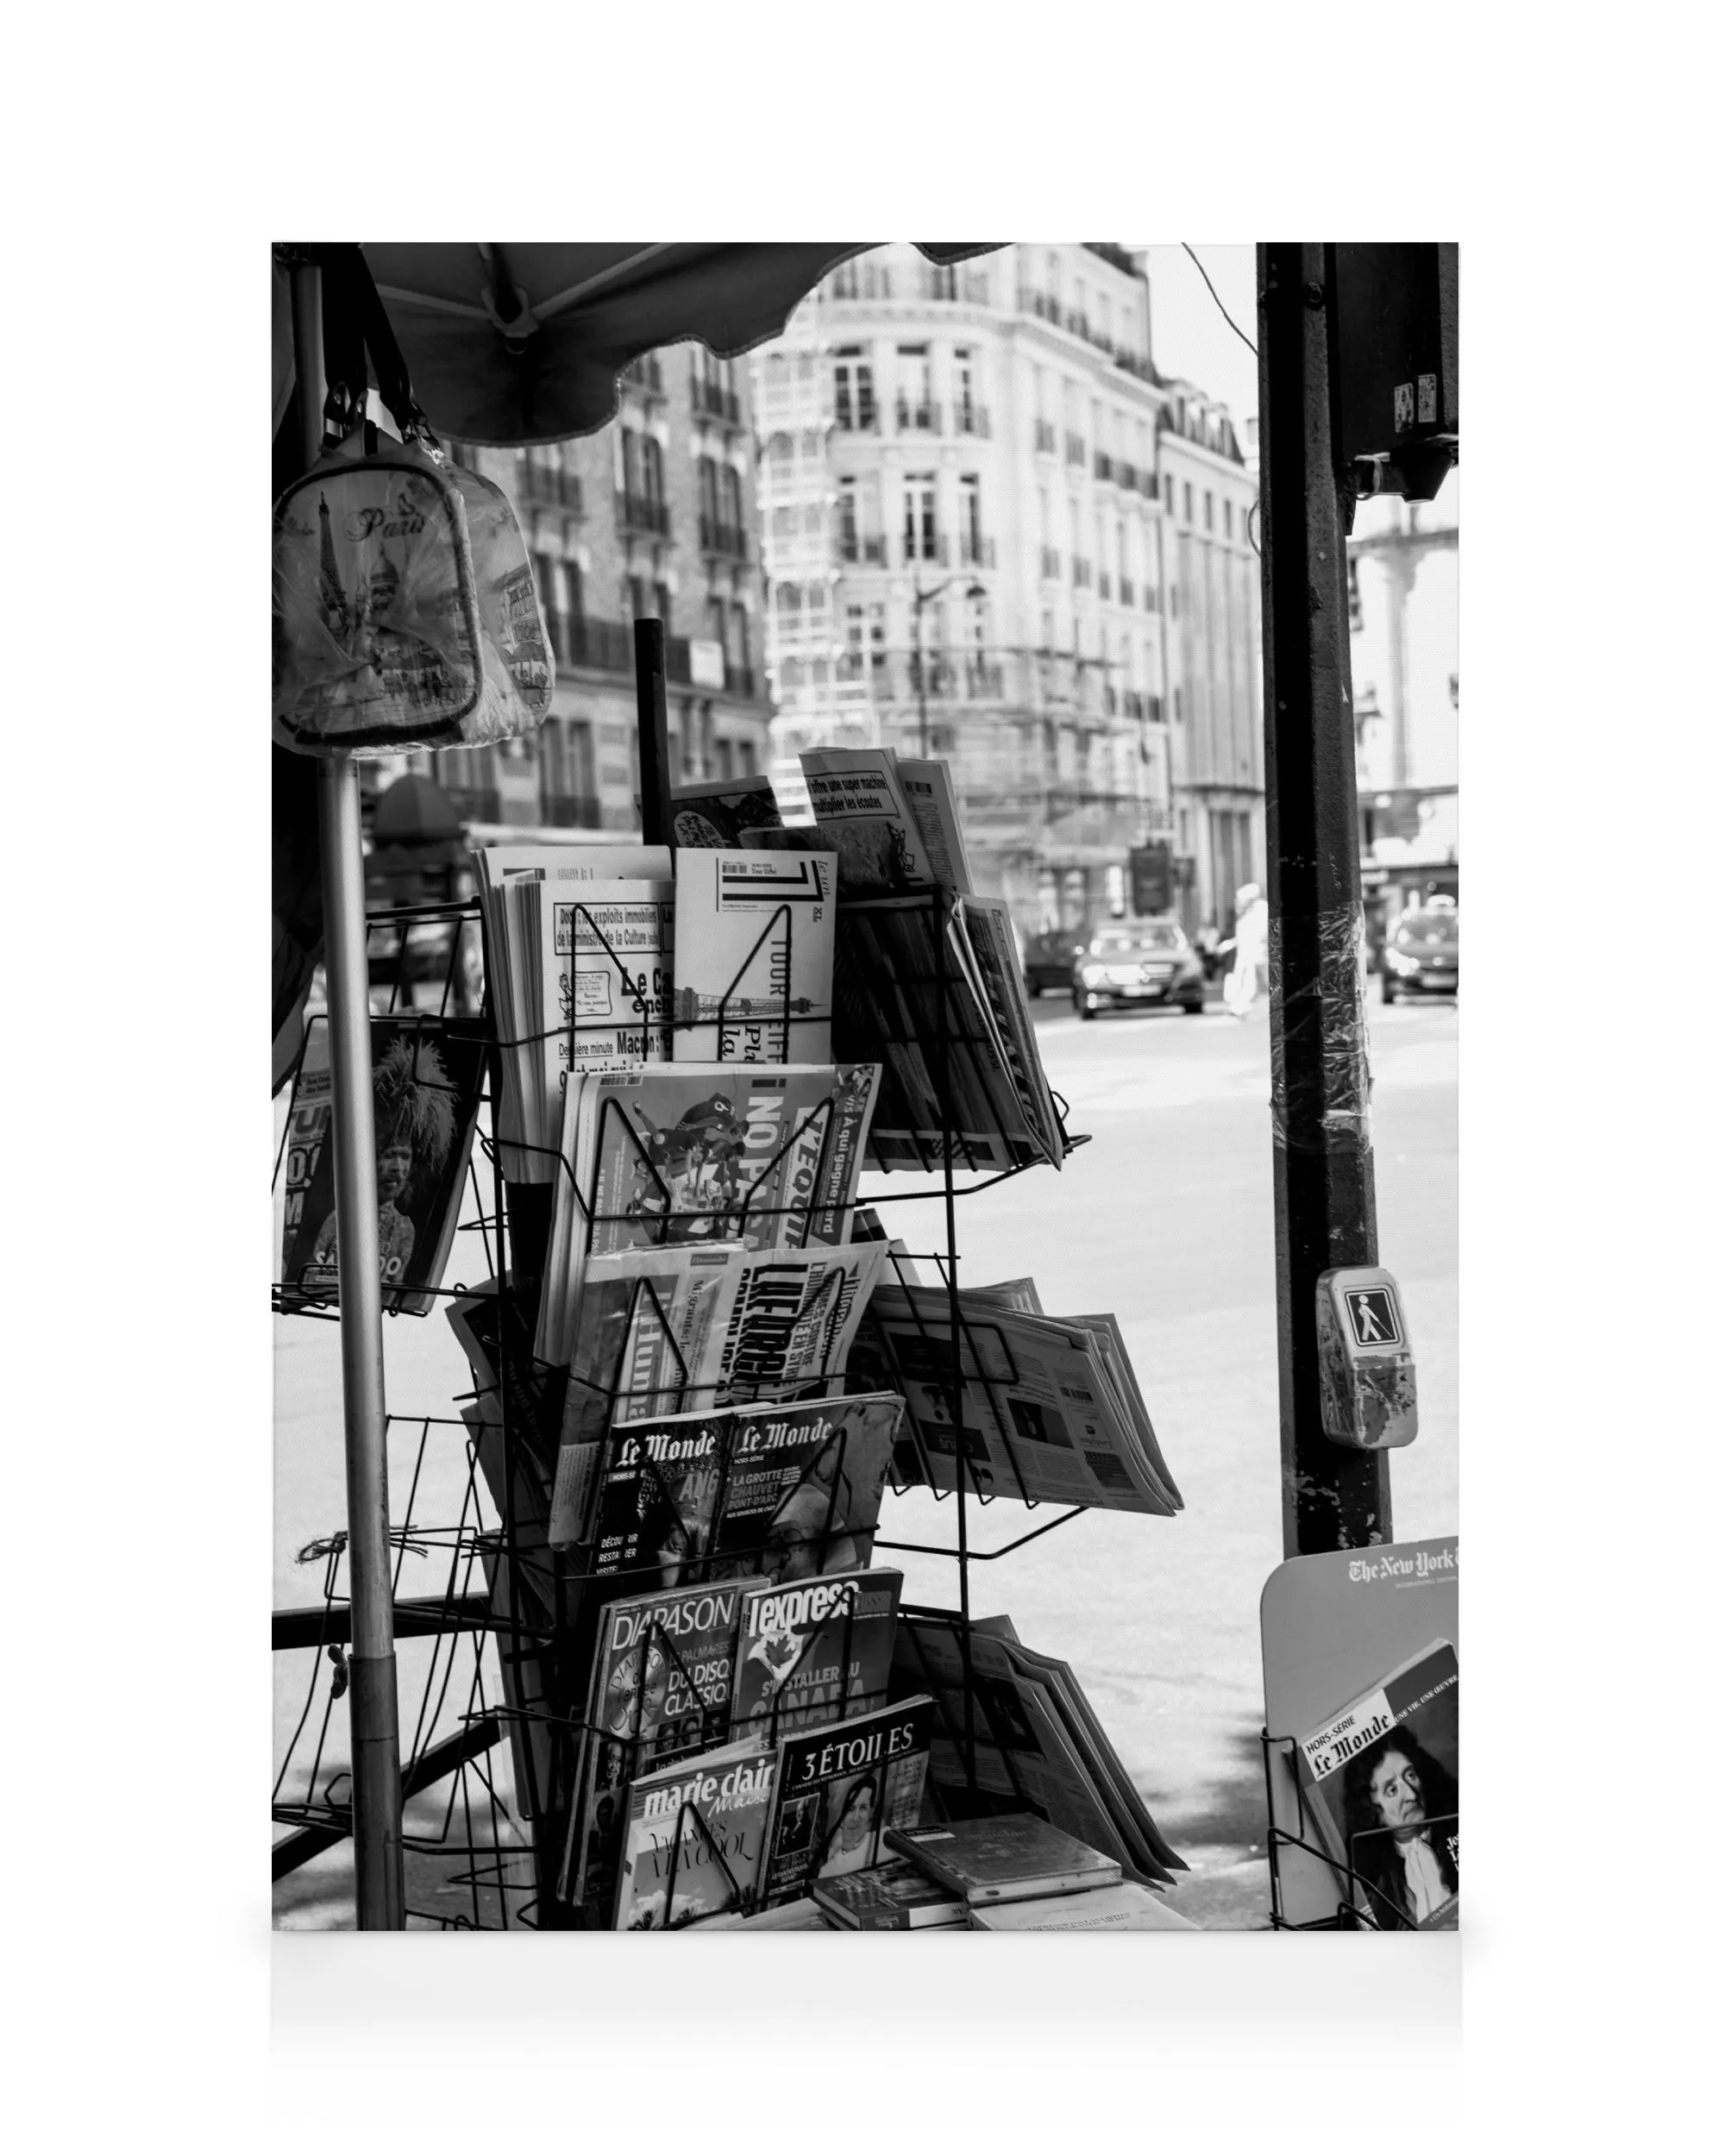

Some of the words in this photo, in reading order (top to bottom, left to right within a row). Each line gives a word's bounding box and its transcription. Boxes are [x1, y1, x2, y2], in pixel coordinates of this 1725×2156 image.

[593, 906, 624, 928] exploits
[624, 928, 647, 945] Culture
[621, 967, 648, 996] Le
[590, 1041, 613, 1054] minute
[837, 1129, 852, 1153] qui
[829, 1153, 849, 1200] gagne
[615, 1437, 642, 1467] Le
[644, 1429, 717, 1463] Monde
[736, 1426, 762, 1454] Le
[759, 1417, 833, 1451] Monde
[731, 1480, 781, 1499] CHAUVET
[732, 1475, 745, 1487] LA
[745, 1469, 783, 1485] GROTTE
[728, 1492, 779, 1510] PONT-D'ARC
[1348, 1558, 1378, 1583] The
[1379, 1556, 1415, 1580] New
[1415, 1548, 1454, 1577] York
[612, 1593, 735, 1651] DIAPASON
[1306, 1714, 1357, 1755] HORS-SÉRIE
[1313, 1753, 1333, 1778] Le
[1329, 1713, 1389, 1763] Monde
[801, 1752, 818, 1781] 3
[643, 1771, 718, 1818] marie
[720, 1758, 775, 1798] clair
